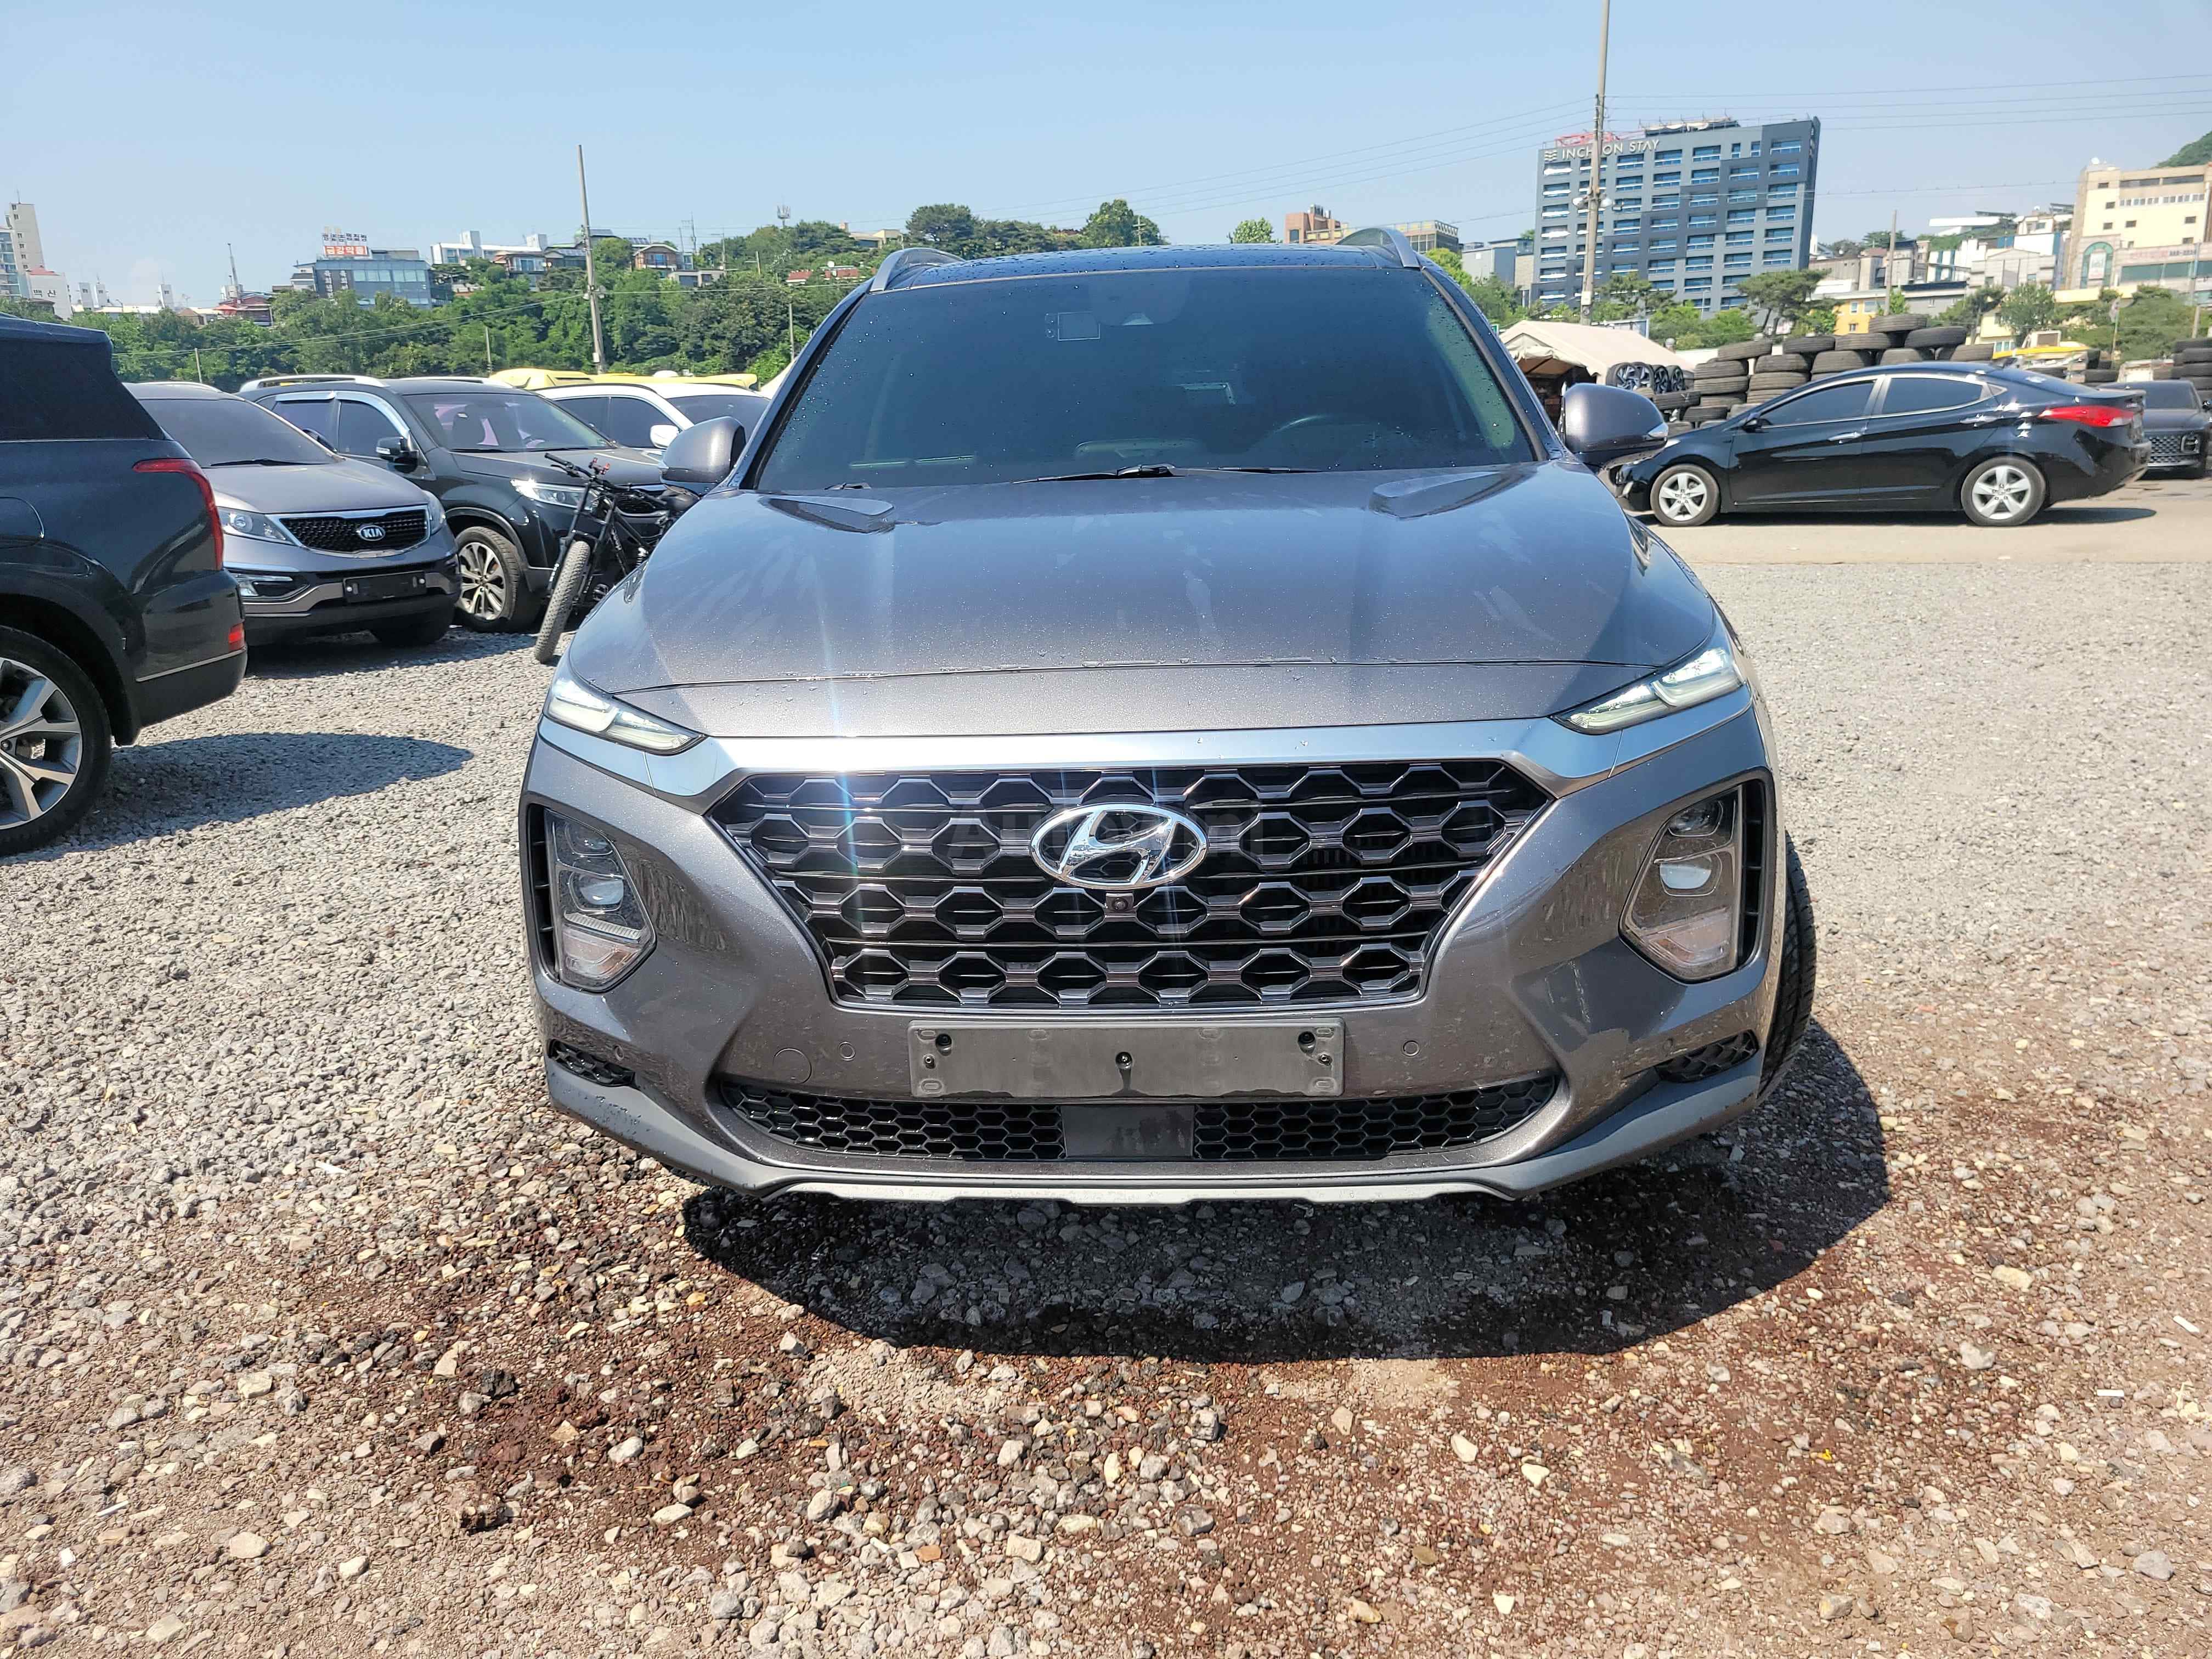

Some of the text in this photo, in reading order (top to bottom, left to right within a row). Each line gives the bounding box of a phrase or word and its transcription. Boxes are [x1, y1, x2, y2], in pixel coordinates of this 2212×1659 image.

[1562, 139, 1660, 159] INCHON STAY
[363, 528, 382, 538] KIA
